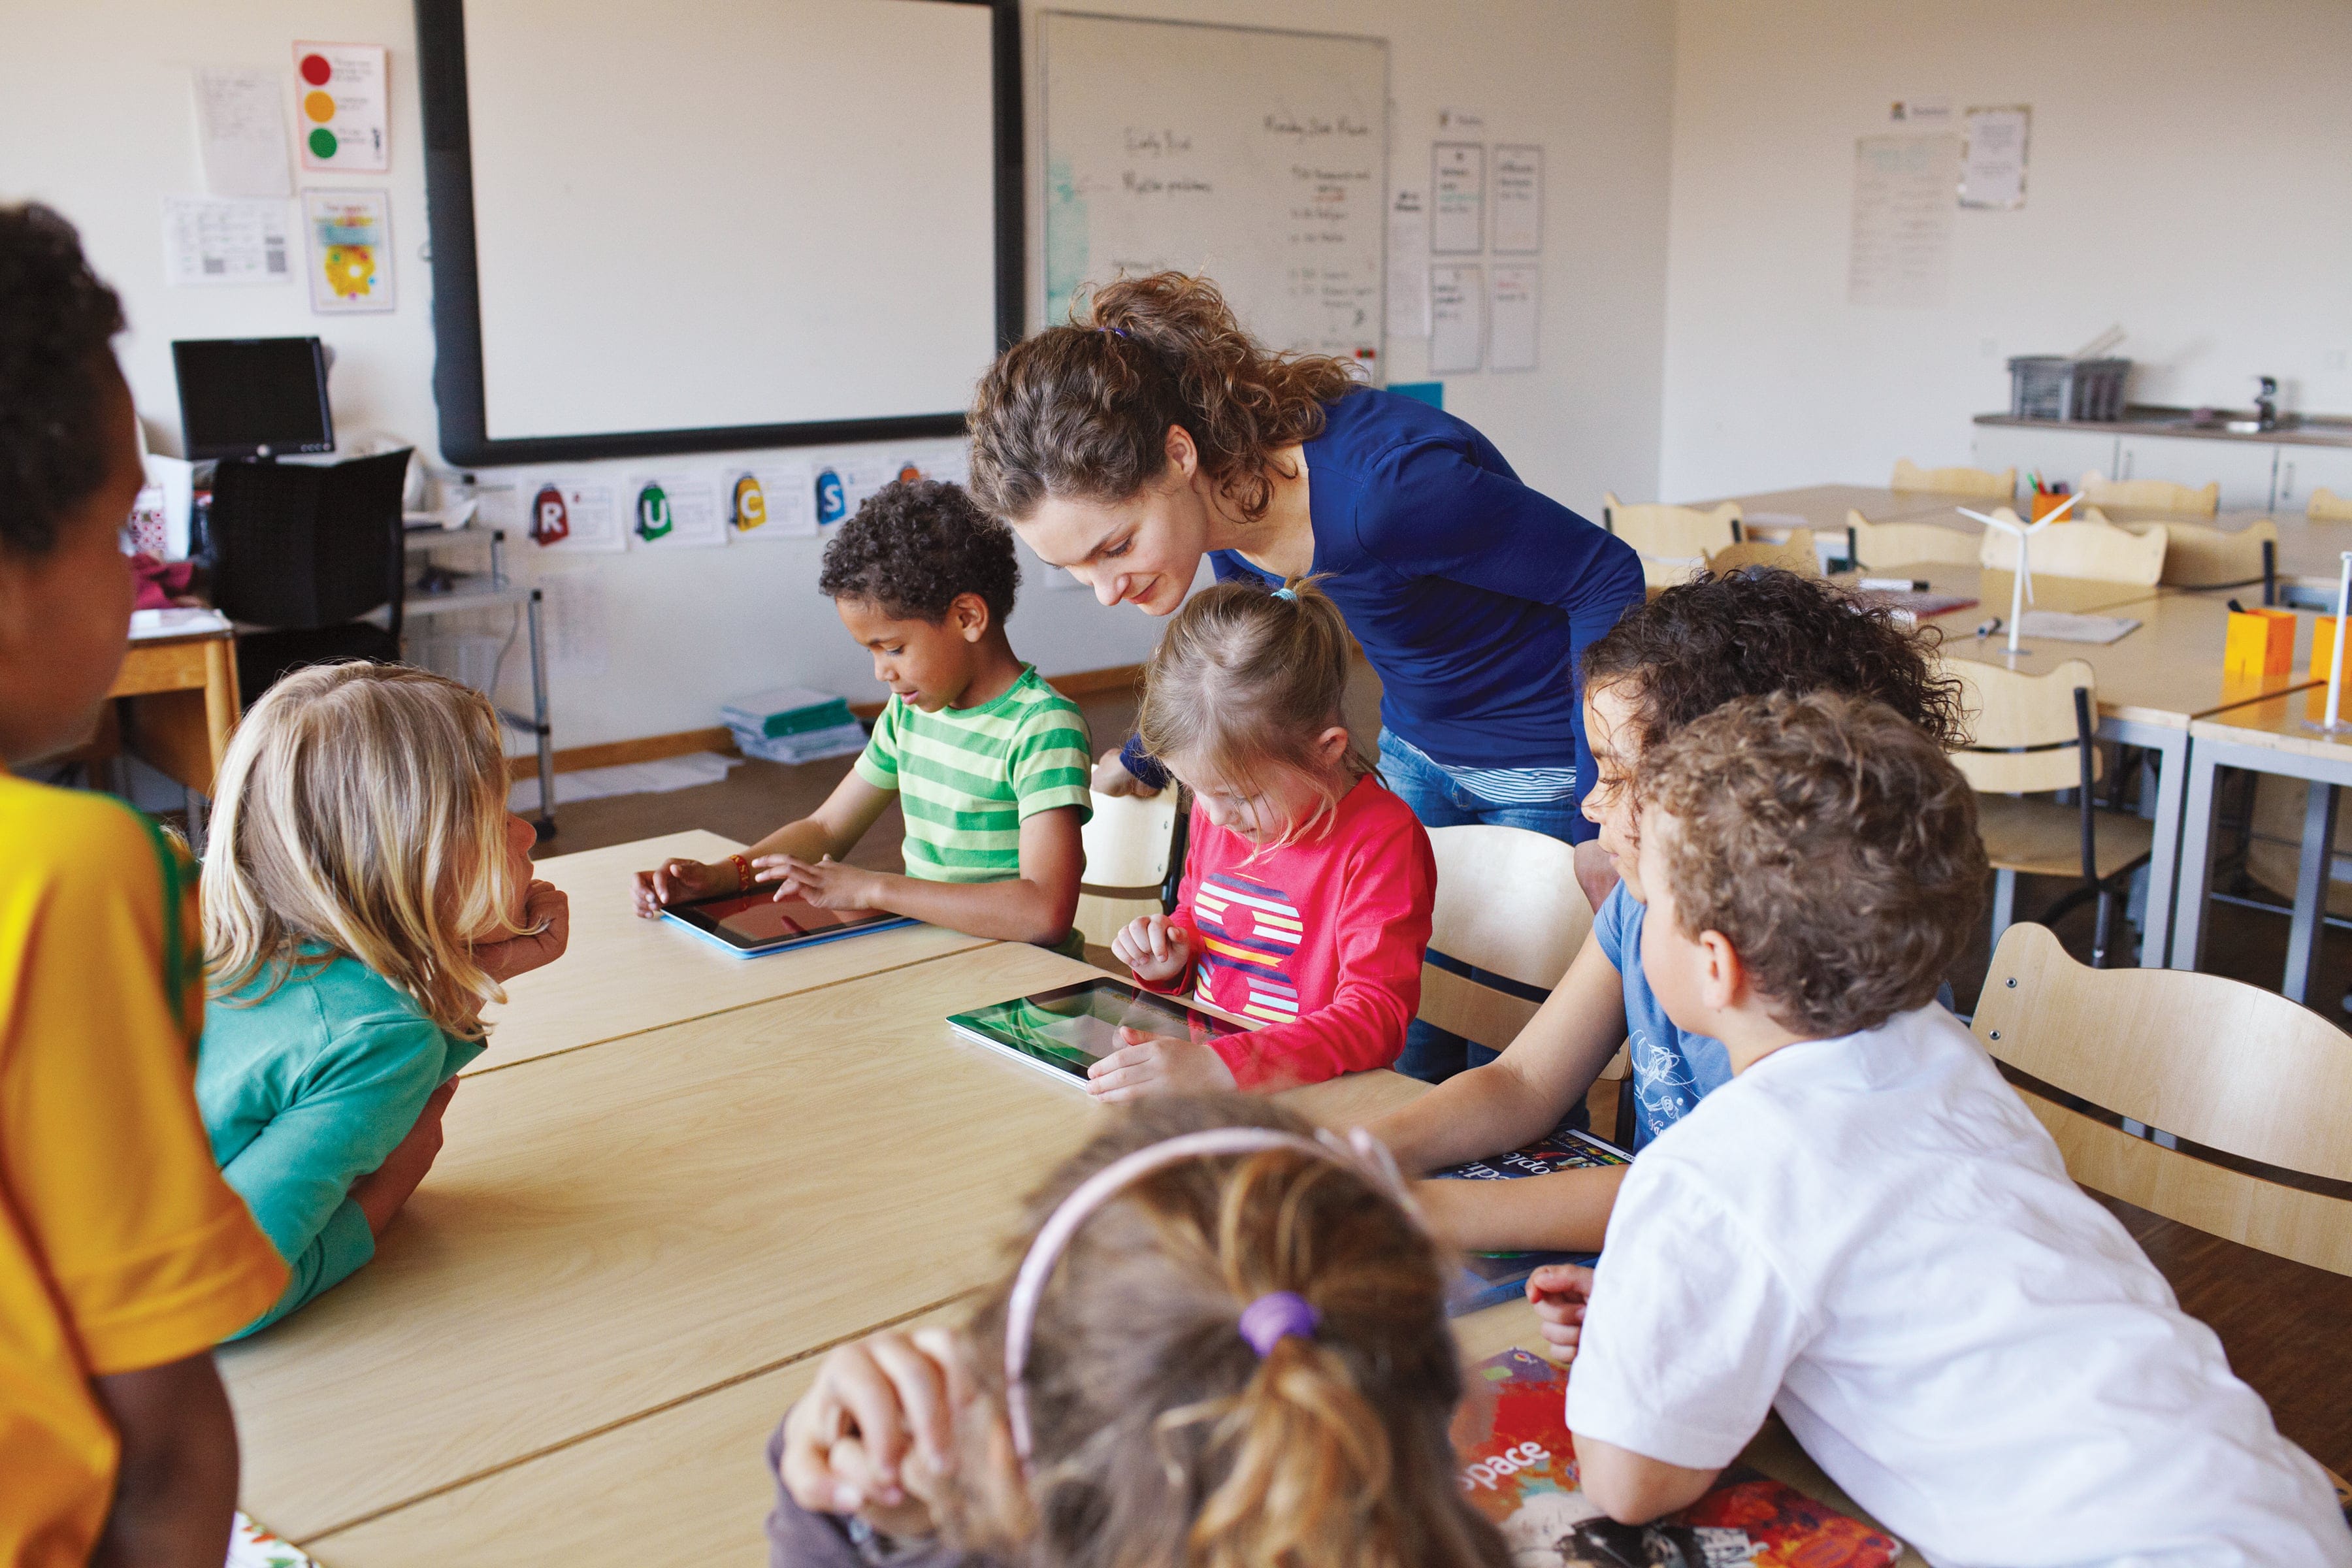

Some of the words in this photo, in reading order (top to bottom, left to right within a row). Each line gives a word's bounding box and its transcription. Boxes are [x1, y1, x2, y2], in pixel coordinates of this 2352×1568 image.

[740, 489, 761, 519] C
[824, 484, 842, 513] S
[541, 502, 564, 534] R
[643, 498, 668, 530] U
[1503, 1152, 1554, 1174] ople
